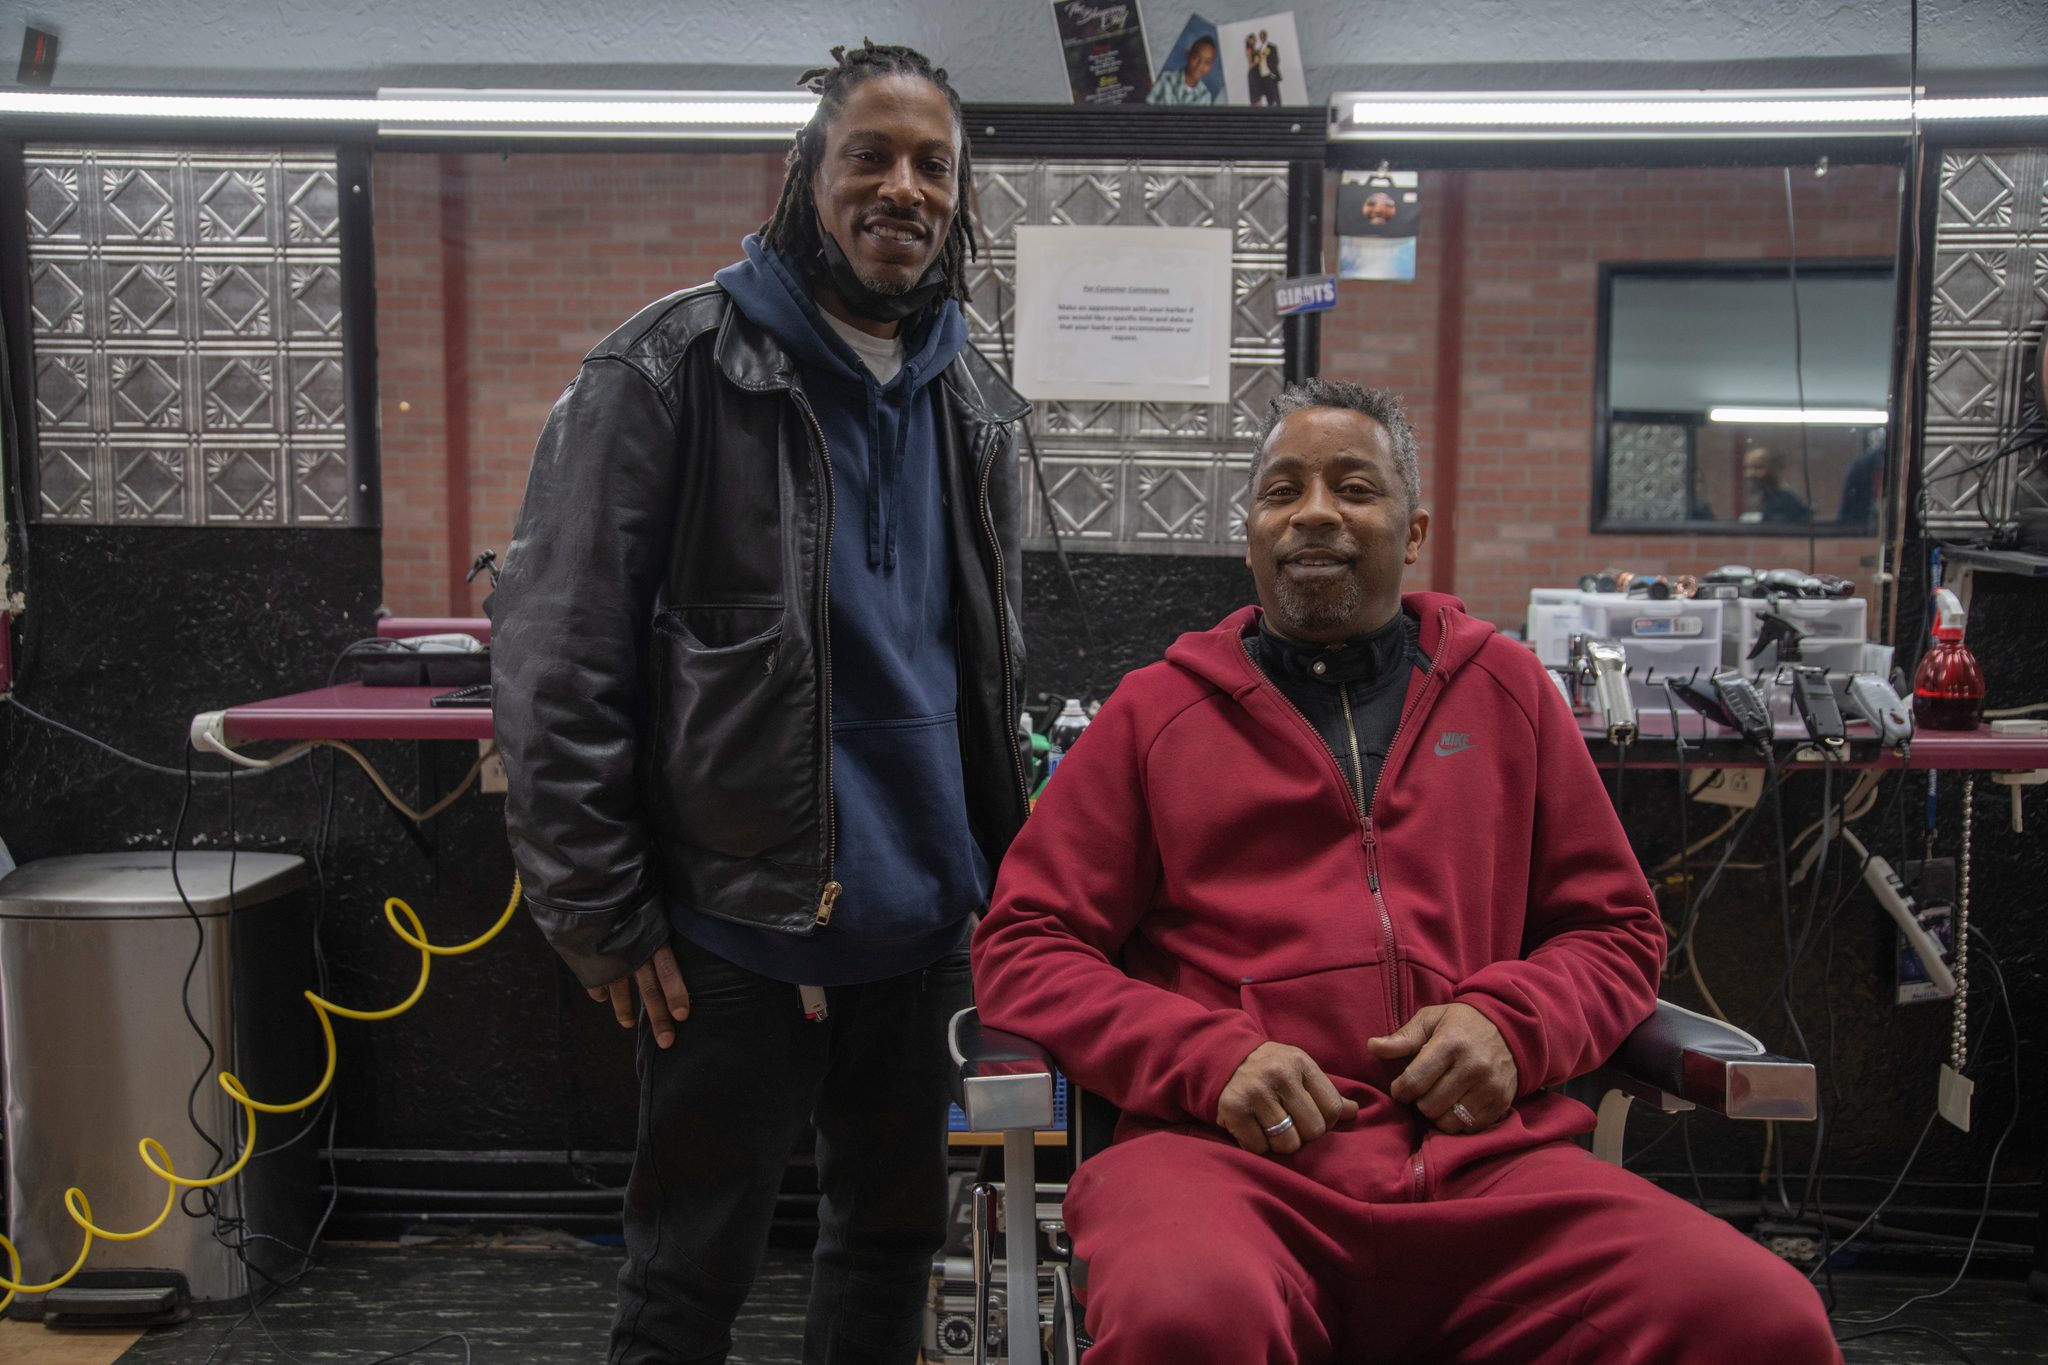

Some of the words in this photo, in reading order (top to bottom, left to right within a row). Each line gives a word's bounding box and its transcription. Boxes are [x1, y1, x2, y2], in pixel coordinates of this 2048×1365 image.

[1083, 285, 1094, 293] For
[1095, 285, 1127, 294] Customer
[1128, 286, 1170, 295] Convenience
[1276, 283, 1335, 307] GIANTS
[1088, 304, 1132, 313] appointment
[1149, 306, 1163, 314] your
[1112, 314, 1136, 323] specific
[1440, 731, 1471, 746] NIKE
